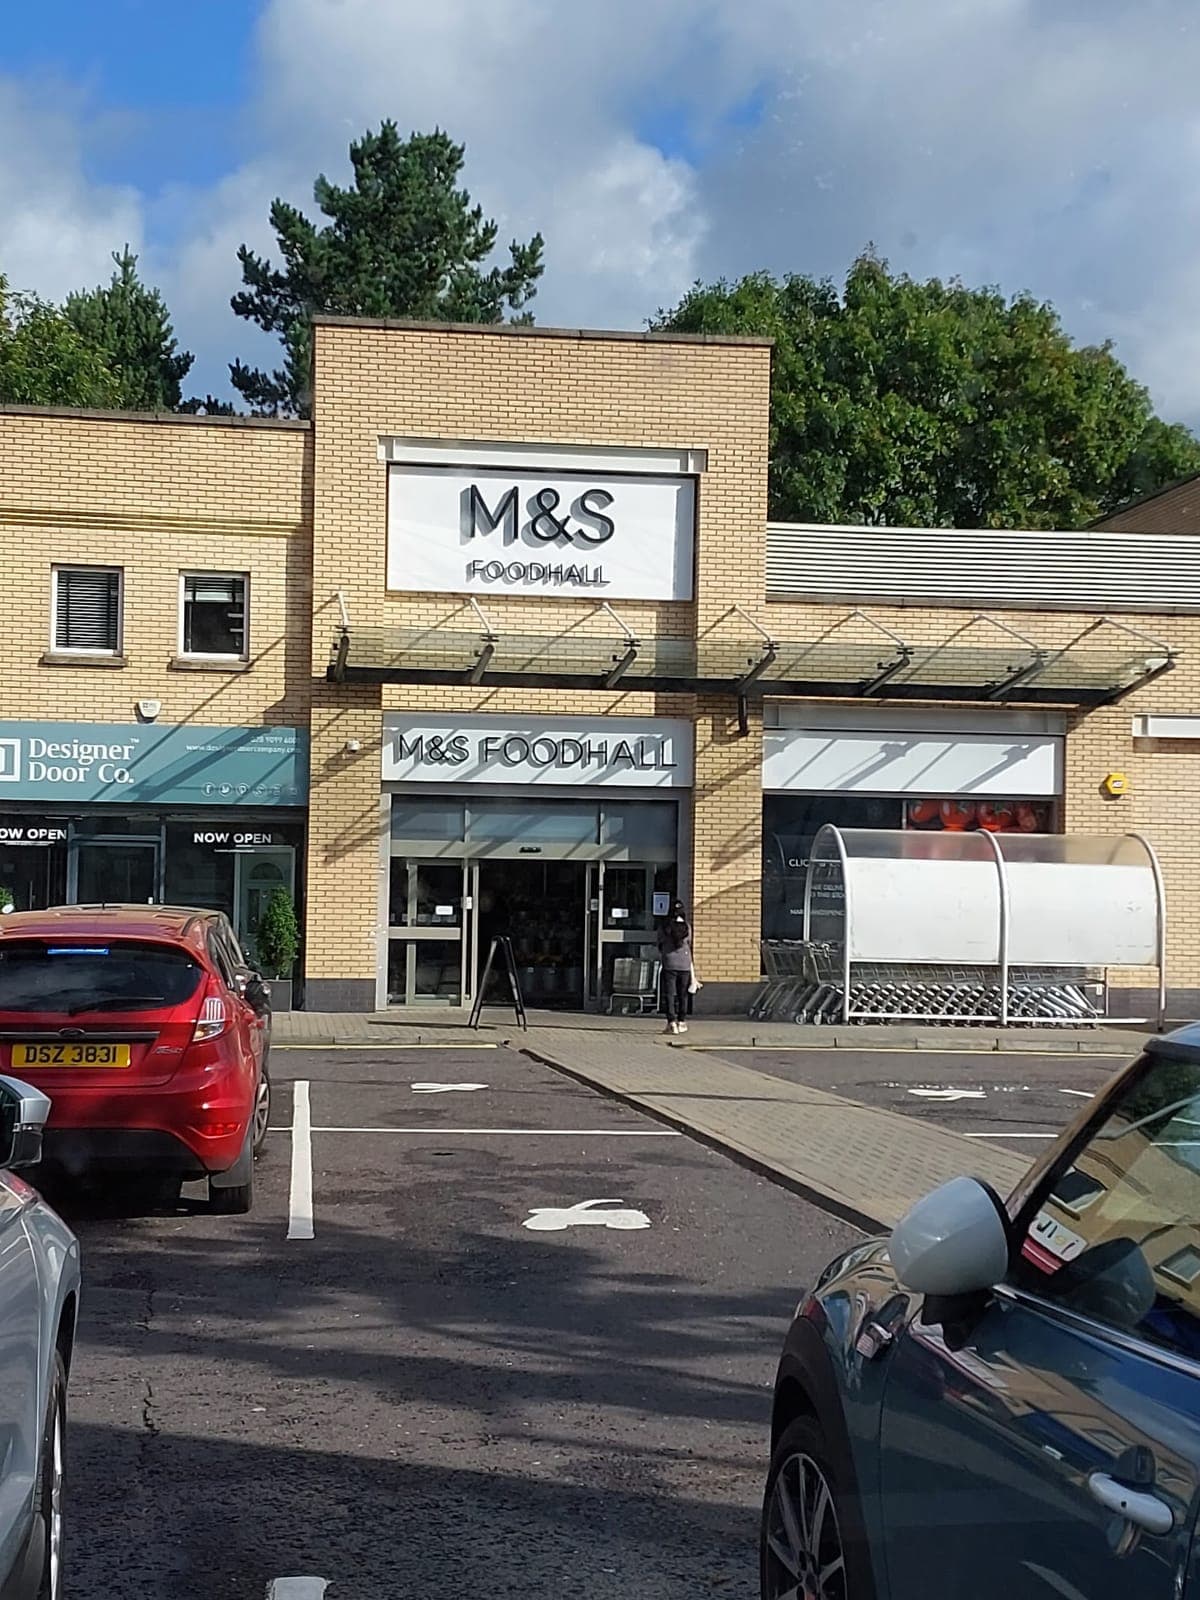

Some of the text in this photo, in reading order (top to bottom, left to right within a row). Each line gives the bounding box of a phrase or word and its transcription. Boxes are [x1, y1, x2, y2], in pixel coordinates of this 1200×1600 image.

[470, 483, 615, 545] M&S
[471, 559, 611, 584] FOODHALL
[28, 738, 135, 766] Designer
[398, 734, 678, 768] M&S FOODHALL
[28, 761, 135, 784] Door Co.
[0, 828, 67, 840] OW OPEN
[193, 832, 272, 844] NOW OPEN
[25, 1046, 117, 1063] DSZ 3831
